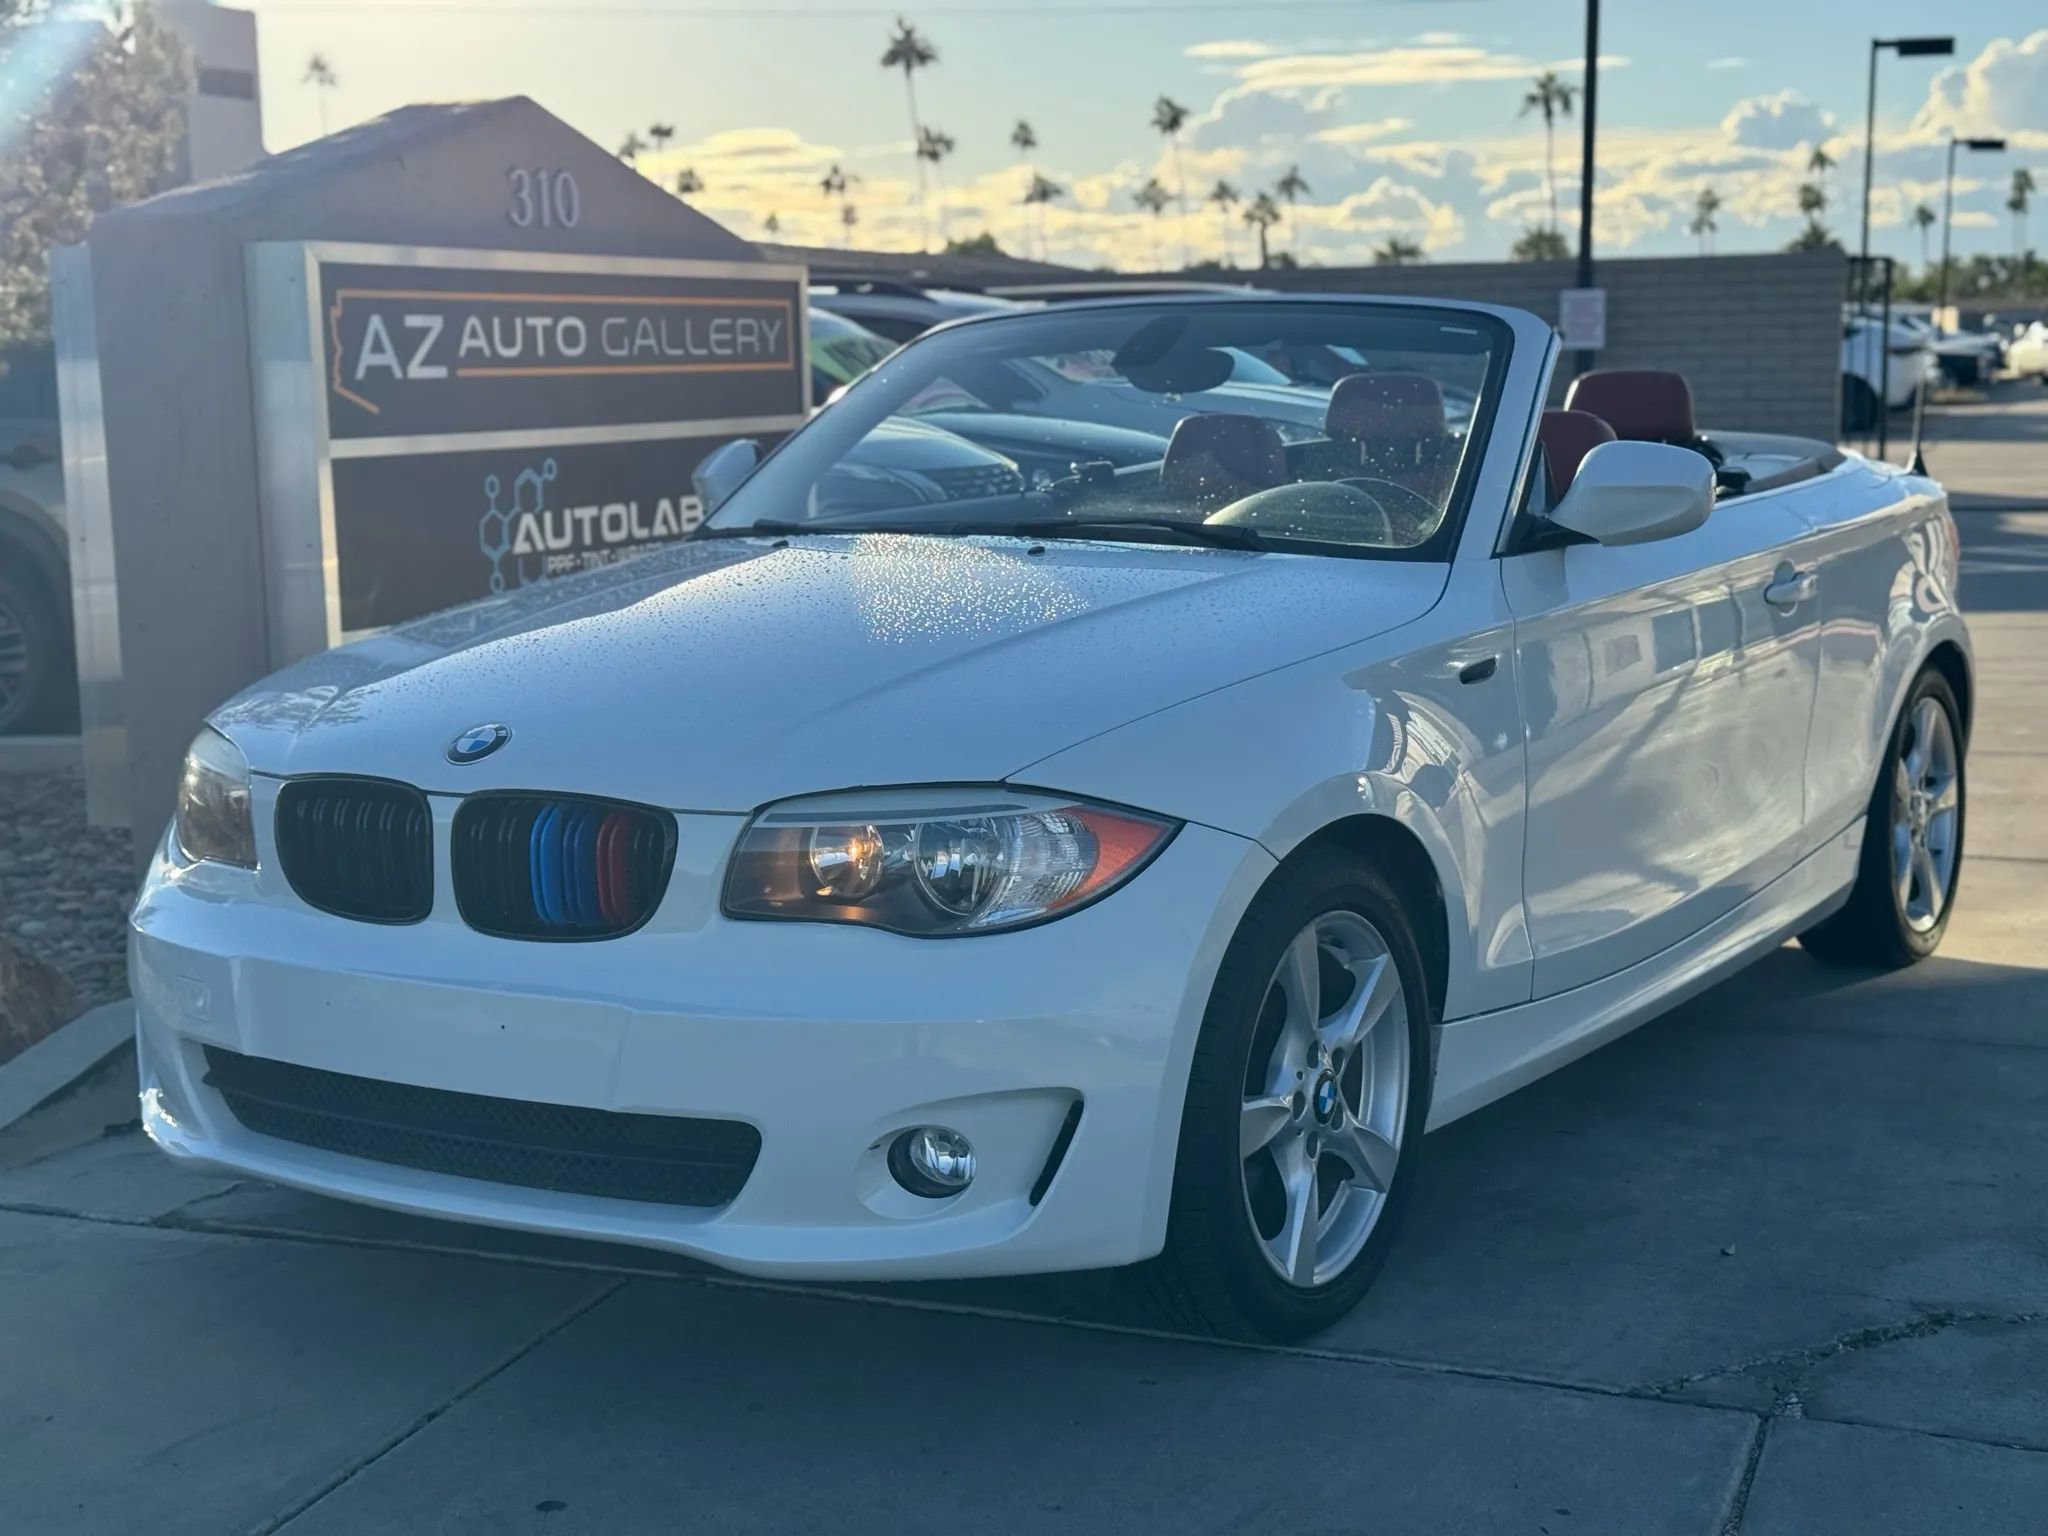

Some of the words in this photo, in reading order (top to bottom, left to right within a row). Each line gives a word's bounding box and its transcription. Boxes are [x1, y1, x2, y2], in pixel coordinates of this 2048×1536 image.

[509, 168, 580, 228] 310
[355, 314, 448, 379] AZ
[459, 315, 587, 358] AUTO
[601, 317, 782, 357] GALLERY
[513, 495, 703, 554] AUTOLAB
